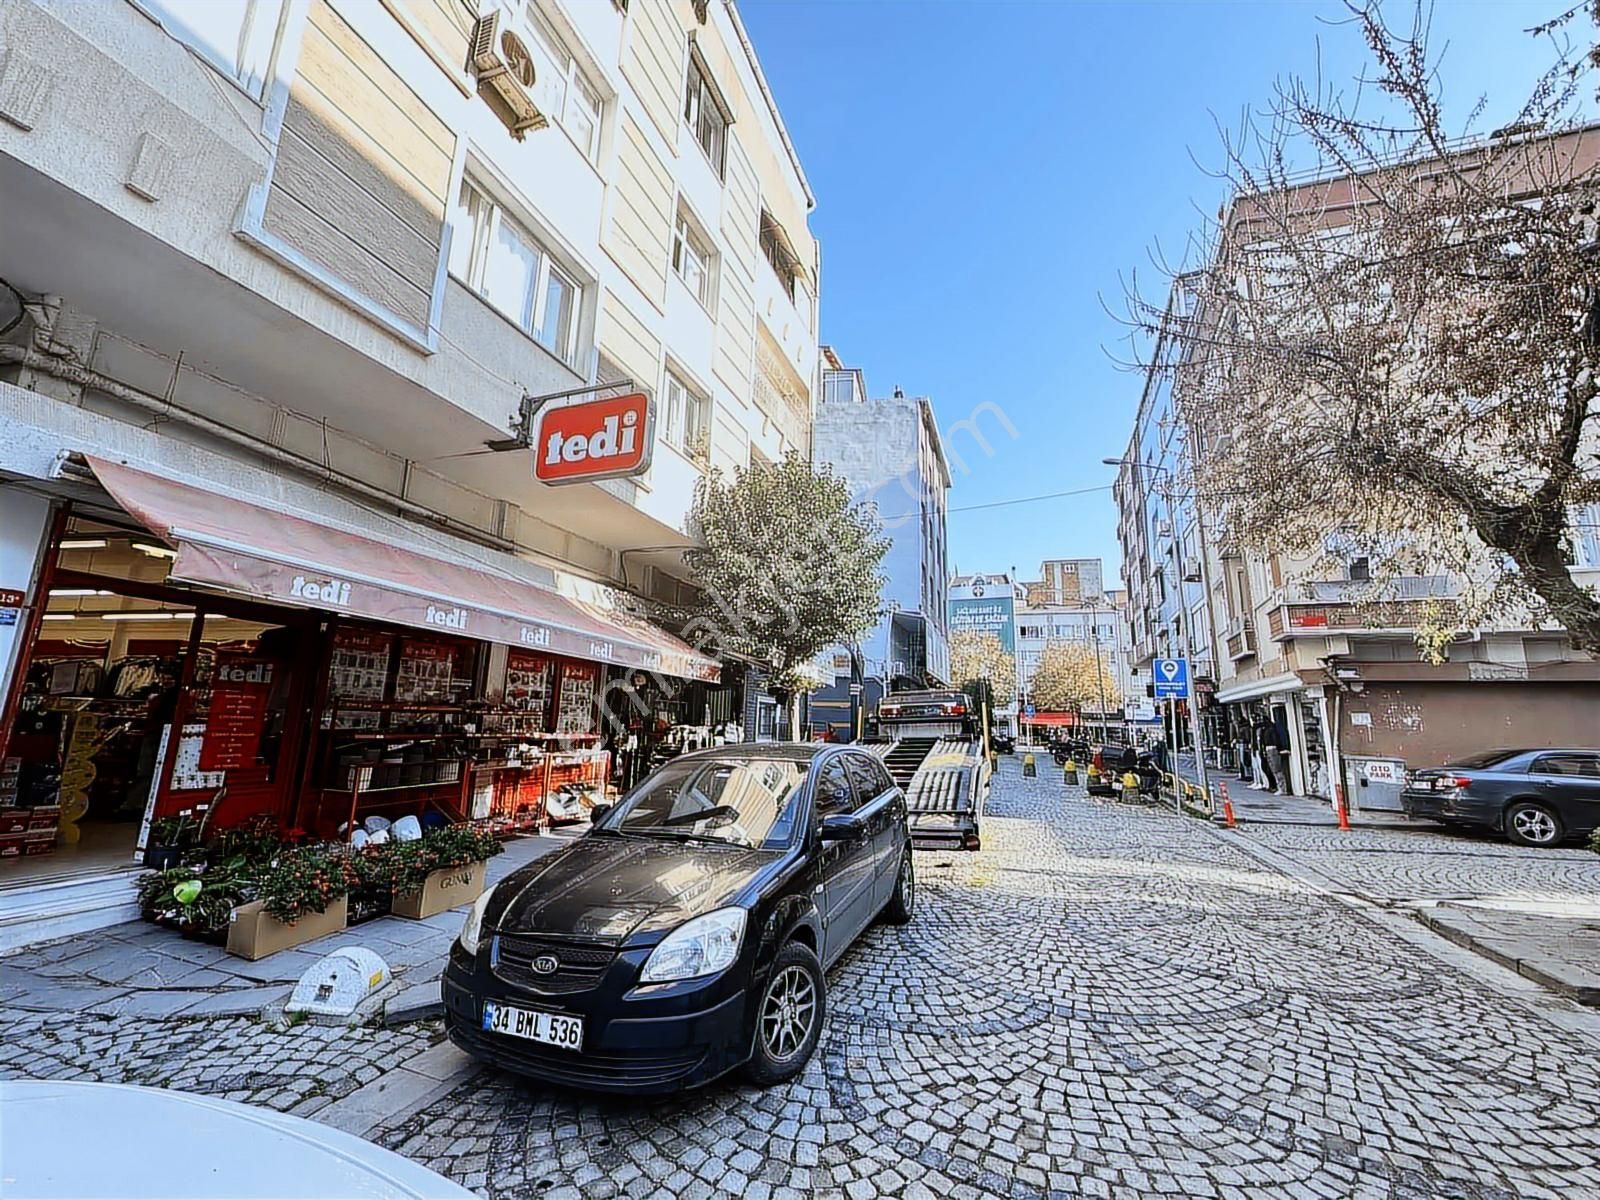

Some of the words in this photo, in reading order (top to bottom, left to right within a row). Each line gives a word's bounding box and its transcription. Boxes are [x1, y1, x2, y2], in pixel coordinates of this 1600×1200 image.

[545, 410, 638, 465] tedi
[291, 576, 350, 606] tedi
[425, 606, 467, 629] tedi
[520, 627, 550, 646] tedi
[219, 664, 273, 684] tedi
[536, 959, 553, 971] KIA
[491, 1004, 510, 1031] 34
[515, 1011, 541, 1038] BML
[548, 1018, 580, 1045] 536
